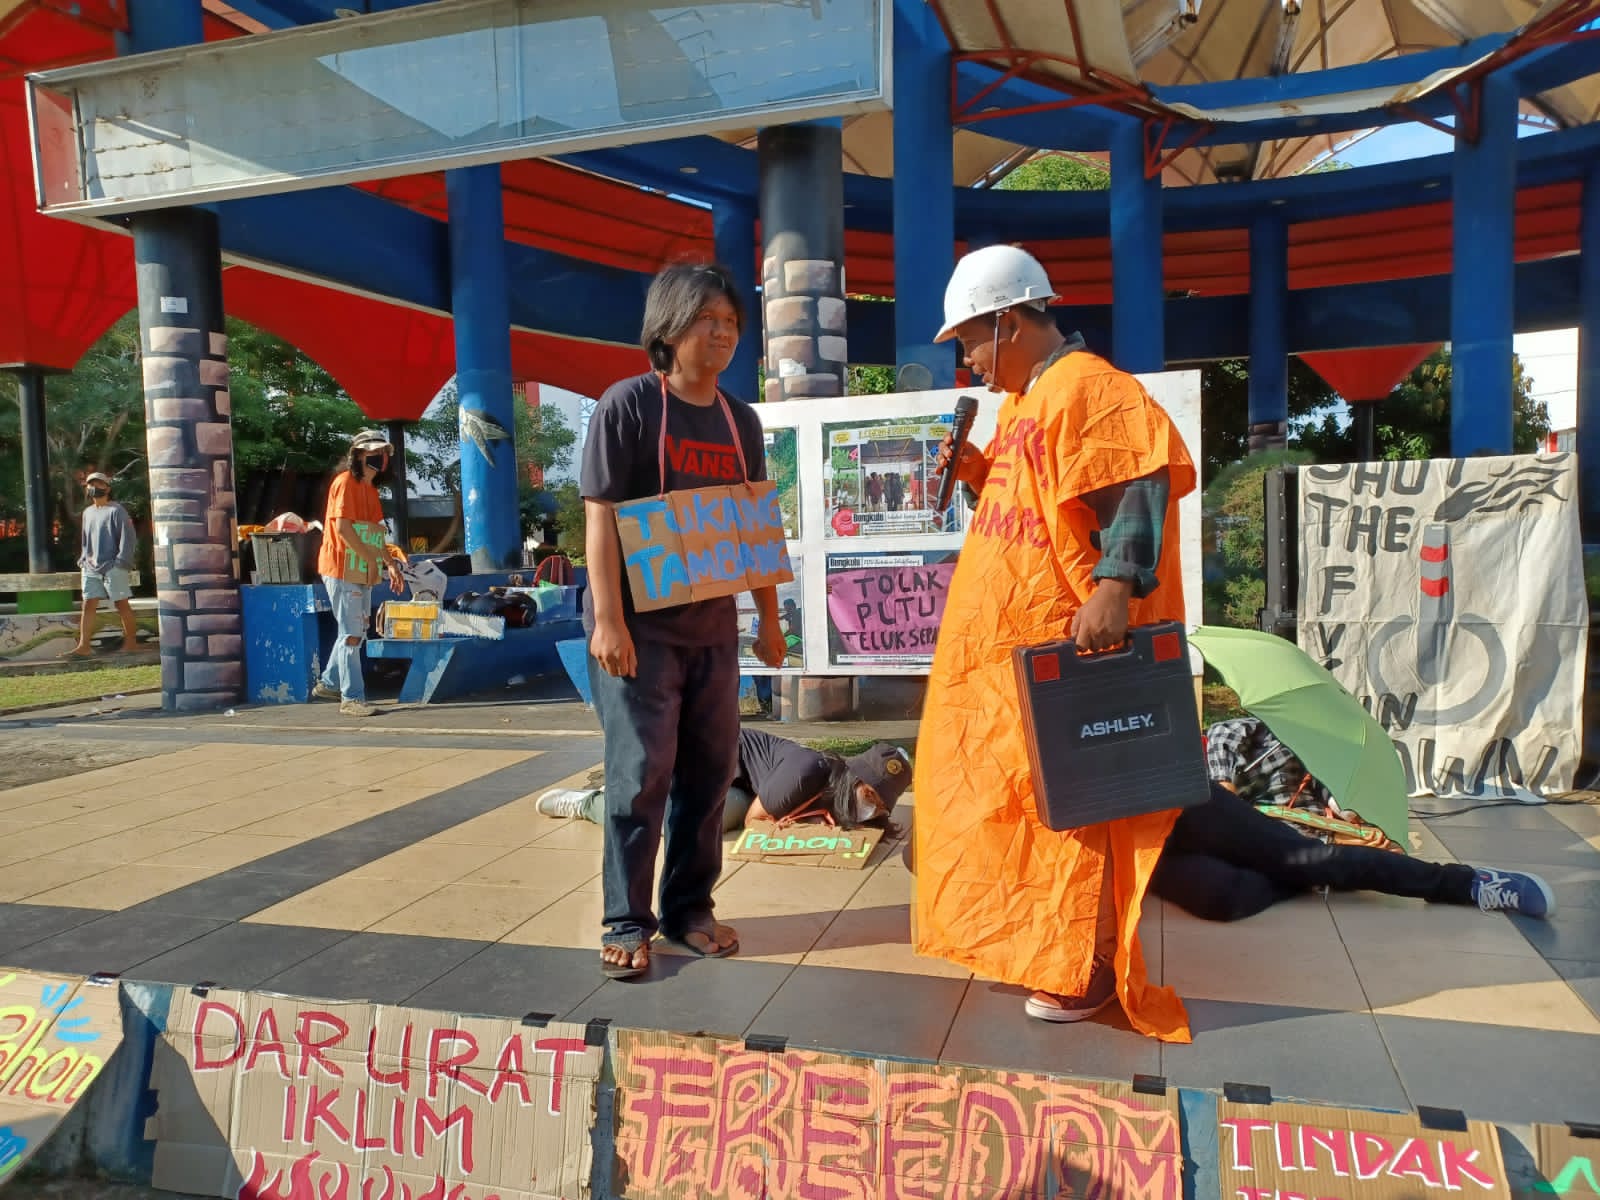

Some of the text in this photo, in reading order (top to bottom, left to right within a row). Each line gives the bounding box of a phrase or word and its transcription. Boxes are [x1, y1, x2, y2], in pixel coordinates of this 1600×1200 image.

[618, 489, 783, 540] TUKANG
[1306, 493, 1415, 556] THE
[853, 570, 943, 599] TOLAK
[856, 595, 936, 629] PLTU
[841, 631, 906, 651] TELUK
[745, 833, 852, 851] Pohon
[192, 1001, 587, 1115] DARURAT
[282, 1084, 474, 1175] IKLIM
[622, 1043, 1184, 1200] FREEDOM
[1221, 1117, 1495, 1191] TINDAK
